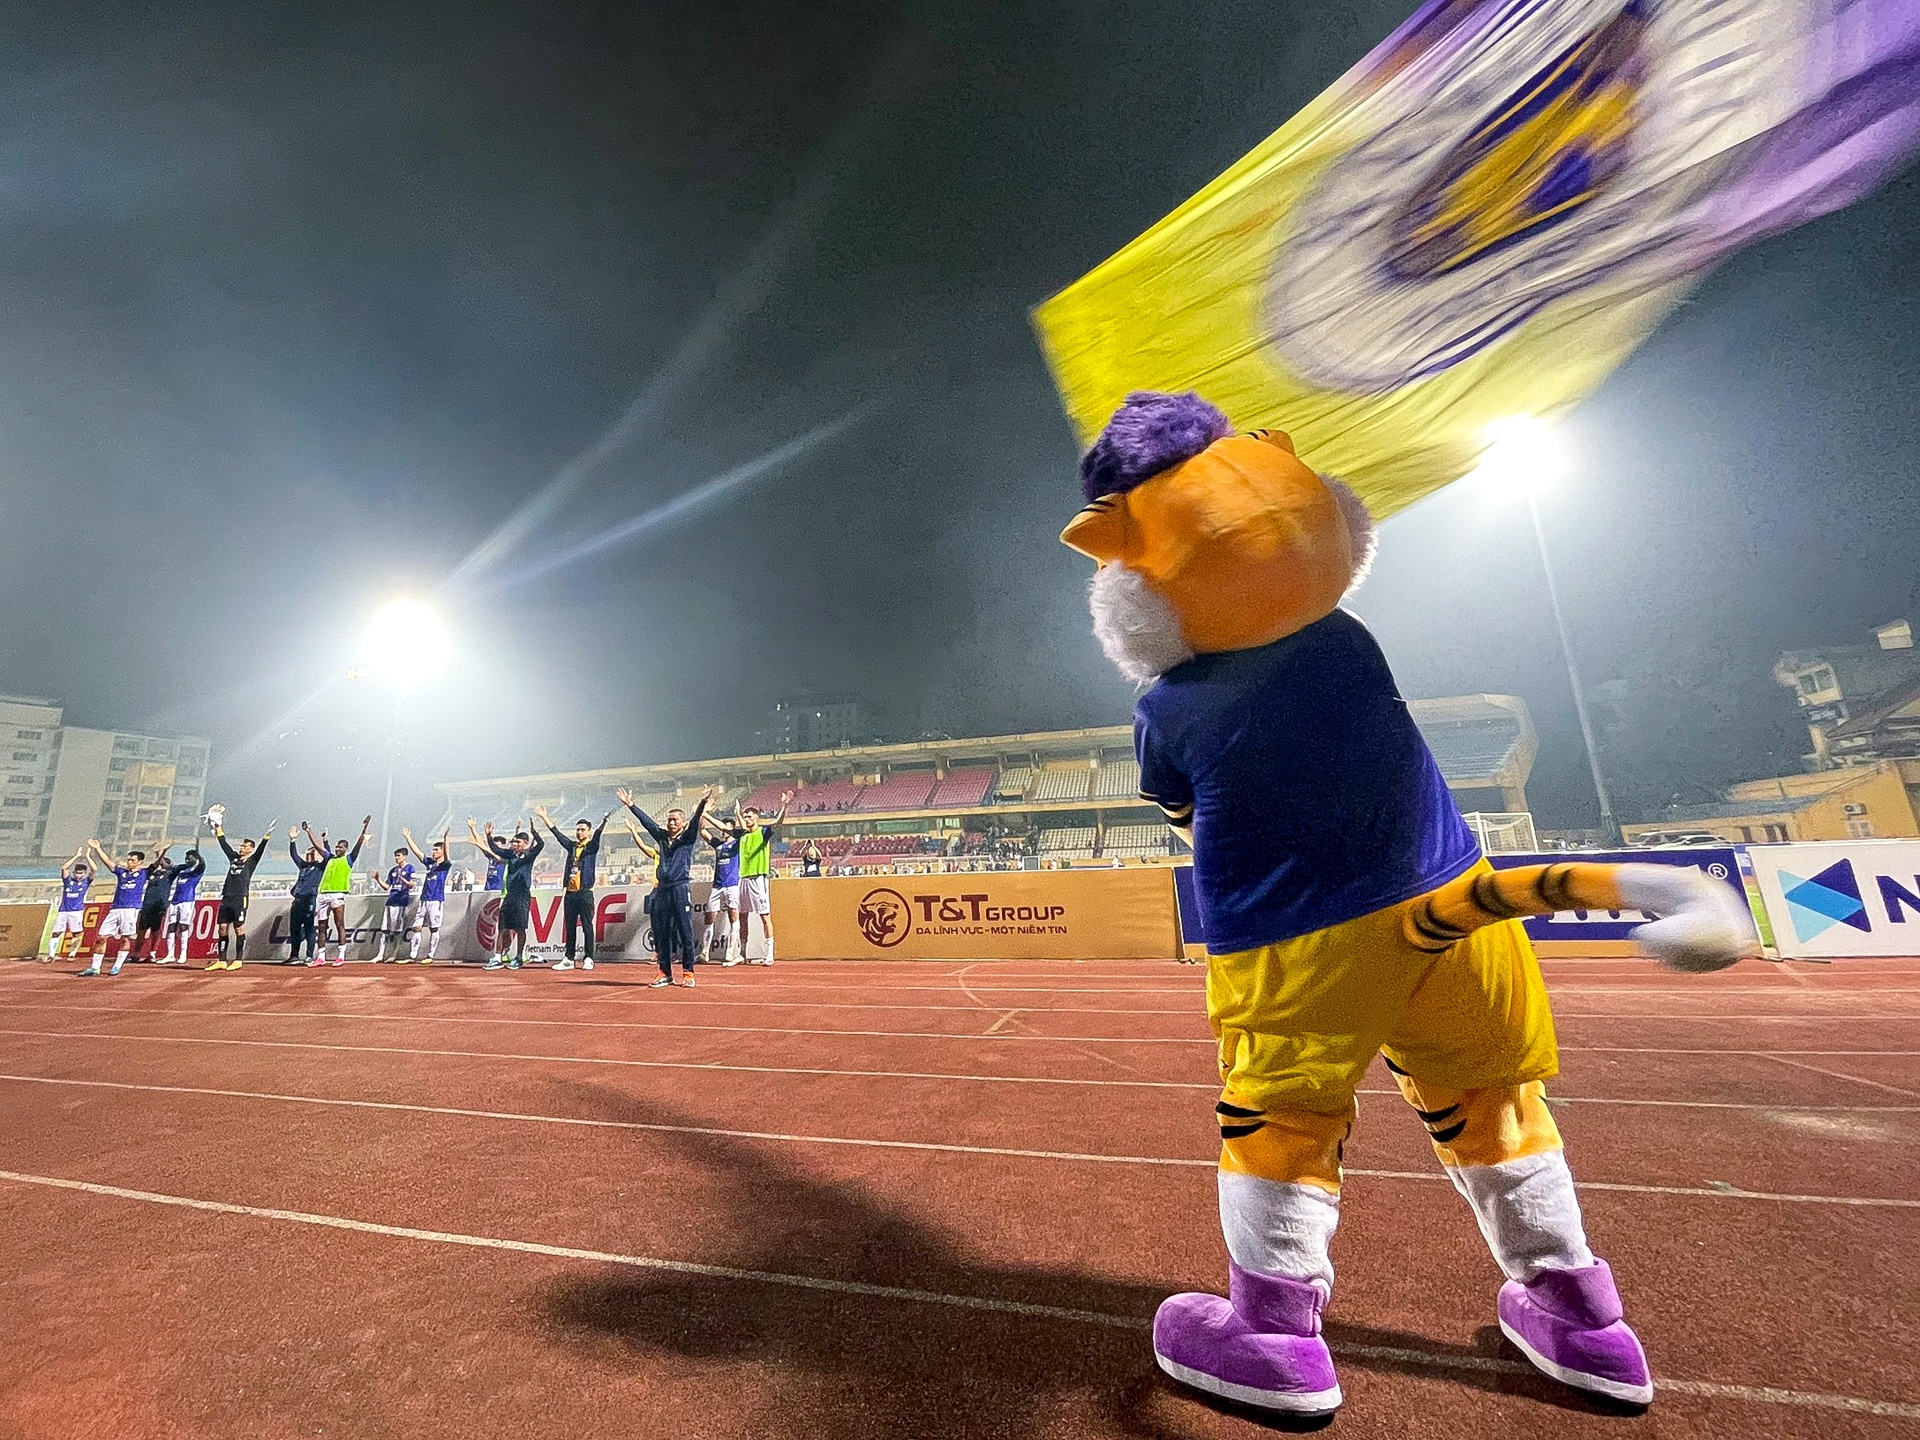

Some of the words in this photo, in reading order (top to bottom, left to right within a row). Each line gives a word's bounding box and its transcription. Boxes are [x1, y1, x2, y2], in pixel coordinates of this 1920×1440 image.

[914, 894, 989, 922] T&T
[986, 906, 1065, 921] GROUP
[1047, 925, 1068, 934] TIN
